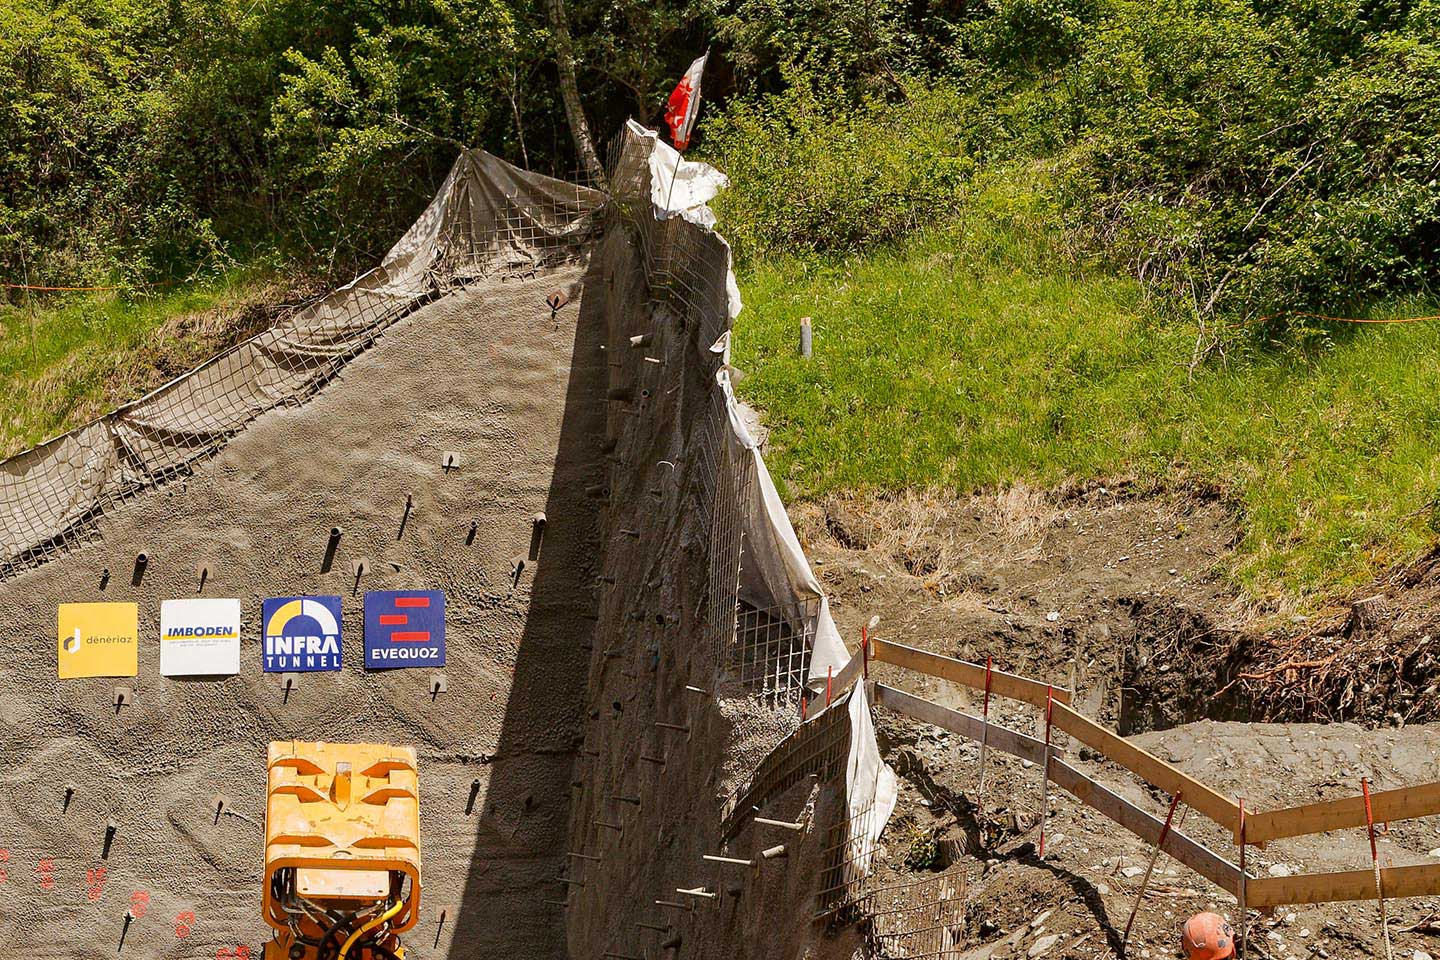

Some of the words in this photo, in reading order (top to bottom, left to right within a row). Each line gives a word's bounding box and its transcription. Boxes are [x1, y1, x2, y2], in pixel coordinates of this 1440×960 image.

[168, 626, 233, 637] IMBODEN
[266, 635, 339, 654] INFRA
[372, 648, 439, 659] EVEQUOZ
[267, 656, 340, 668] TUNNEL
